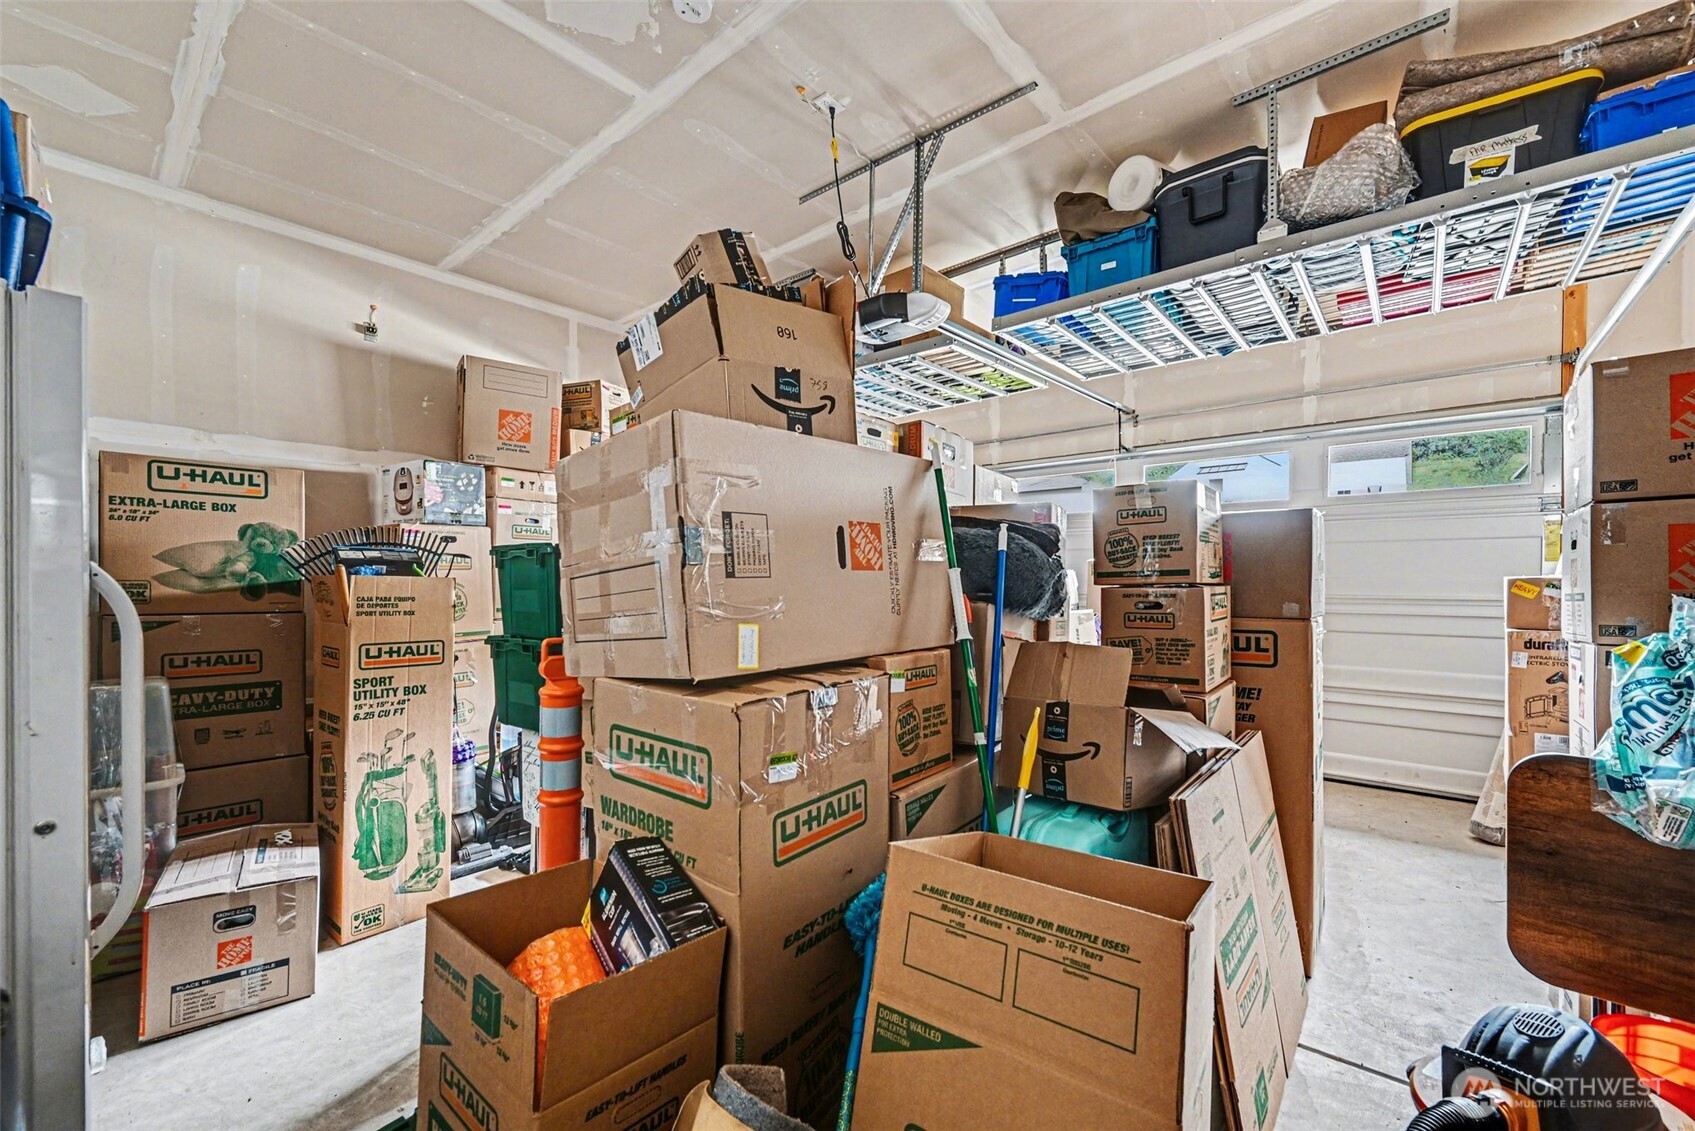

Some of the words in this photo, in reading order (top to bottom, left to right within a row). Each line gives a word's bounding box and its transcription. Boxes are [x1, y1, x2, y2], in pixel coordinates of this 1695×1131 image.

[780, 383, 799, 393] prime
[1668, 452, 1692, 463] get
[156, 465, 261, 488] U-HAUL
[108, 495, 206, 512] EXTRA-LARGE
[211, 502, 237, 513] BOX
[888, 486, 899, 551] HDMOVING.COM
[1120, 510, 1163, 520] U-HAUL
[515, 527, 550, 535] U-HAUL
[861, 522, 882, 553] DEPOT
[849, 521, 883, 571] HOME
[1108, 535, 1134, 549] 100%
[854, 544, 867, 567] THE
[1128, 615, 1172, 623] U-HAUL
[1602, 626, 1619, 636] USA
[365, 645, 440, 660] U-HAUL
[168, 653, 257, 669] U-HAUL
[906, 667, 935, 682] U-HAUL
[353, 676, 394, 689] SPORT
[172, 686, 275, 705] EAVY-DUTY
[353, 687, 399, 701] UTILITY
[404, 684, 427, 696] BOX
[173, 701, 243, 714] TRA-LARGE
[247, 699, 271, 707] BOX
[354, 702, 367, 710] 15"
[1235, 701, 1252, 711] TAY
[353, 711, 375, 721] 6.25
[378, 709, 391, 718] CU
[393, 707, 405, 716] FT
[1047, 726, 1065, 734] prime
[616, 734, 704, 784] U-HAUL
[600, 794, 673, 842] WARDROBE
[780, 796, 864, 844] U-HAUL
[686, 855, 697, 869] FT
[216, 910, 235, 918] MOVE
[363, 914, 382, 926] OK
[921, 883, 949, 899] U-HAUL
[950, 892, 975, 906] BOXES
[975, 900, 993, 912] ARE
[993, 905, 1035, 925] DESIGNED
[1037, 918, 1054, 931] FOR
[1056, 925, 1100, 945] MULTIPLE
[1101, 938, 1131, 954] USES!
[941, 903, 966, 919] Moving
[979, 915, 1003, 930] Moves
[1016, 927, 1047, 944] Storage
[1055, 940, 1078, 954] 10-12
[1081, 947, 1104, 962] Years
[217, 937, 252, 968] HOME
[176, 982, 200, 991] PLACE
[879, 1008, 908, 1028] DOUBLE
[910, 1020, 941, 1042] WALLED
[889, 1023, 907, 1037] EXTRA
[876, 1027, 910, 1048] PROTECTION
